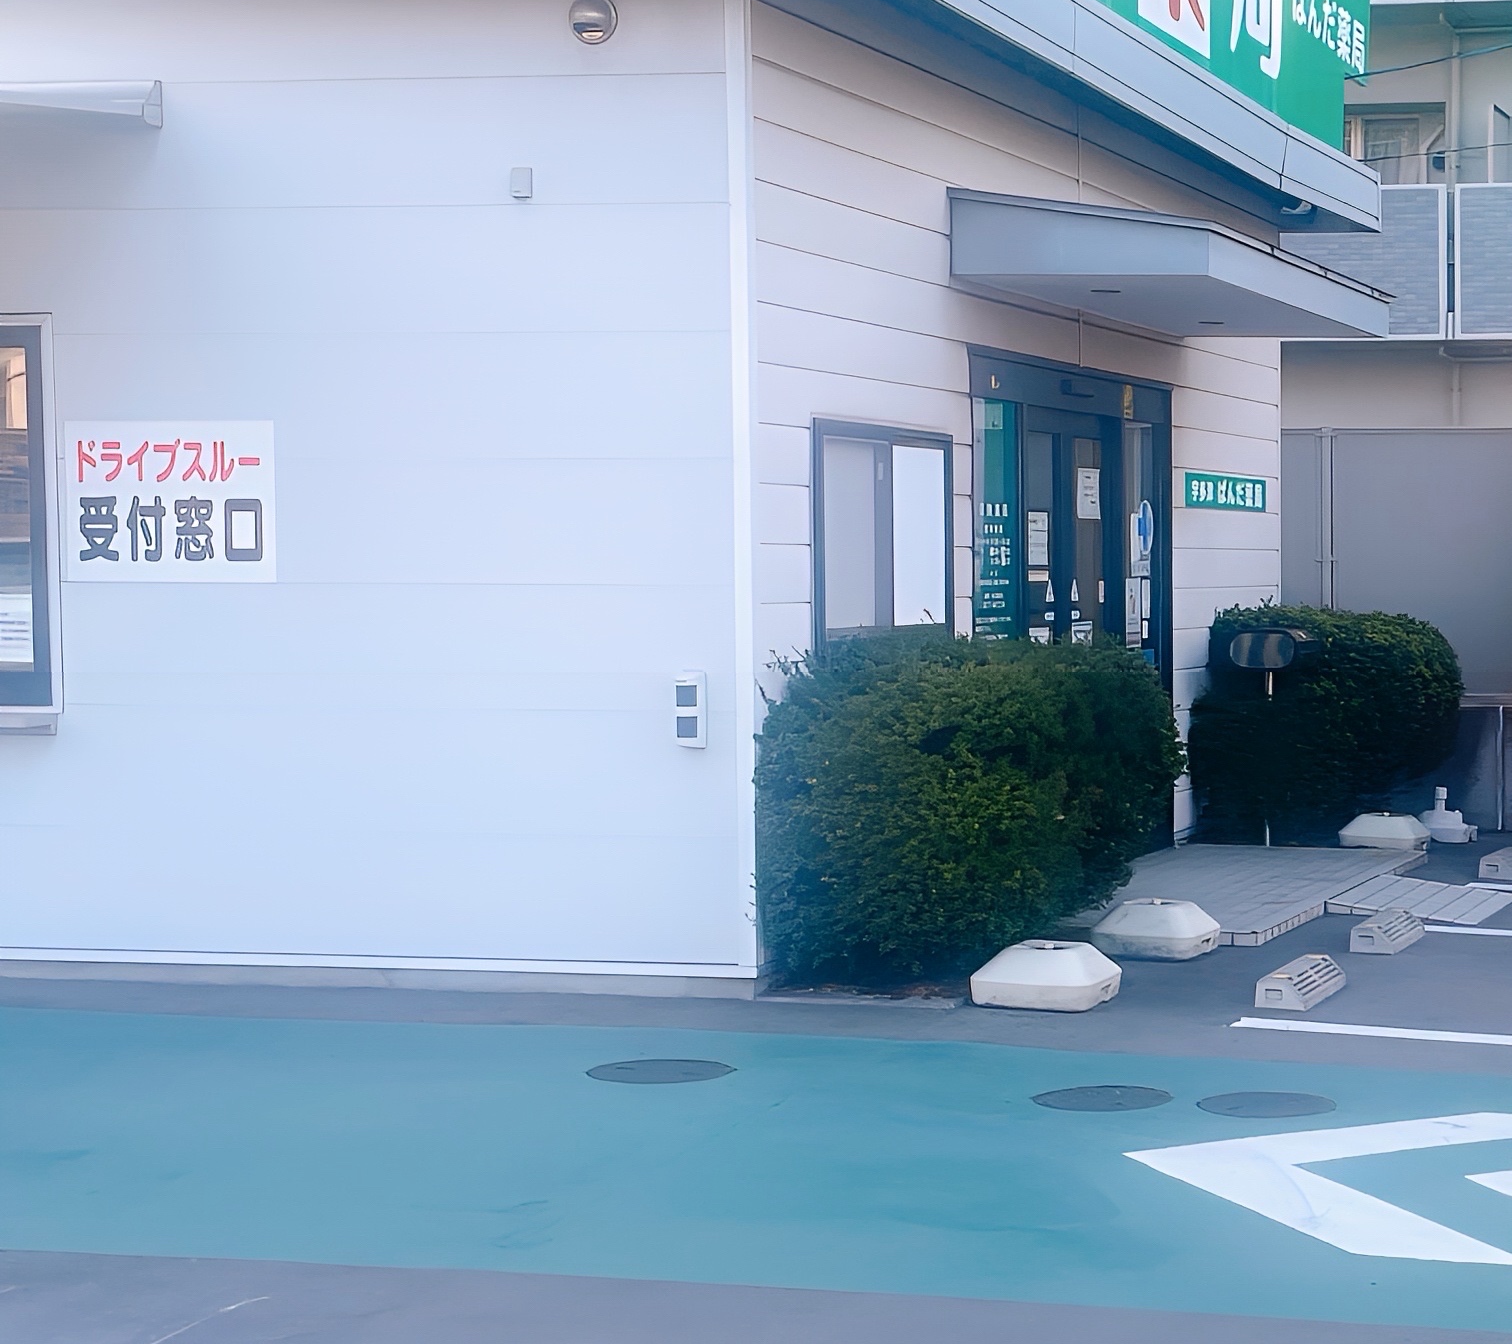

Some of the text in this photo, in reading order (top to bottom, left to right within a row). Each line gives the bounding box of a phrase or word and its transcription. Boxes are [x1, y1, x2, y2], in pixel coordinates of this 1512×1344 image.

[77, 438, 261, 483] ドライブスルー
[79, 495, 263, 562] 受付窓口
